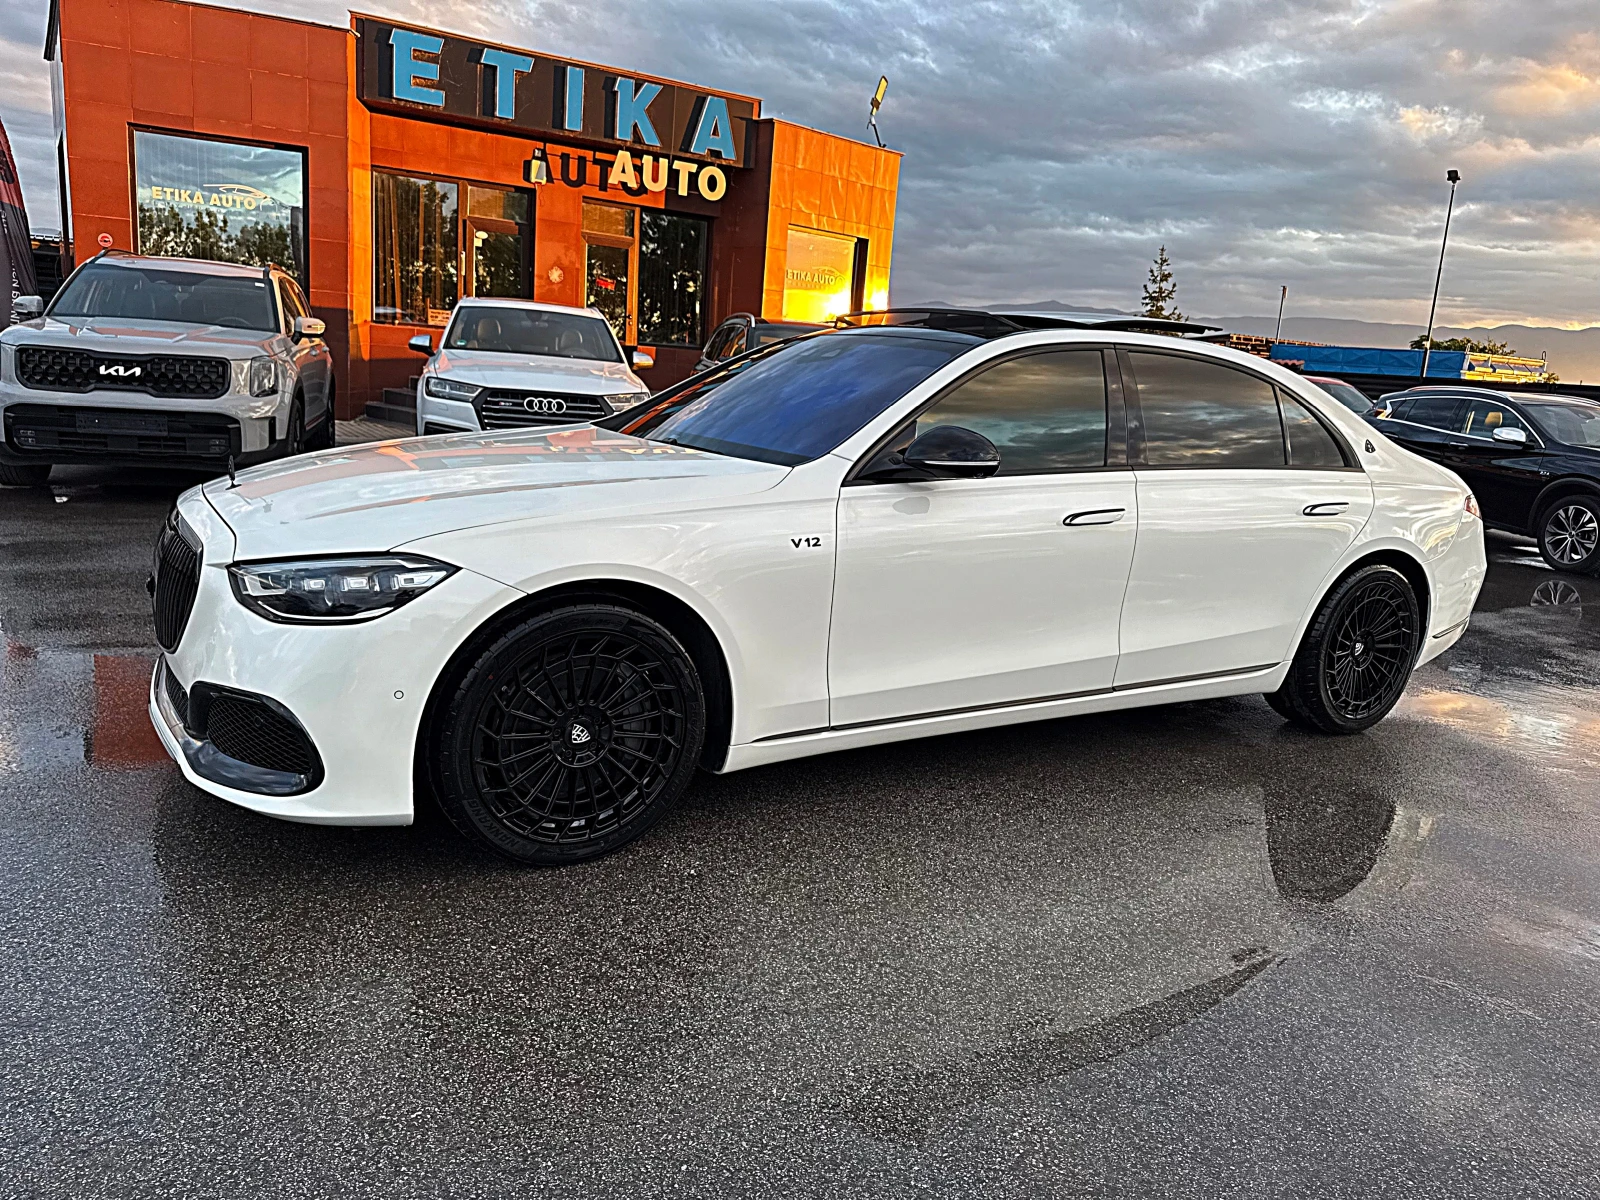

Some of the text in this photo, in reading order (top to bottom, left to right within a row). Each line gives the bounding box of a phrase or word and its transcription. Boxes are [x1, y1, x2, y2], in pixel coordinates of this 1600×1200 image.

[390, 28, 736, 161] ETIKA
[608, 150, 726, 202] AUTO
[151, 186, 205, 205] ETIKA
[209, 193, 257, 211] AUTO
[787, 269, 812, 282] ETIKA
[813, 272, 836, 286] AUTO
[99, 364, 141, 377] KIA
[790, 537, 822, 549] V12
[466, 799, 521, 848] NANKANG
